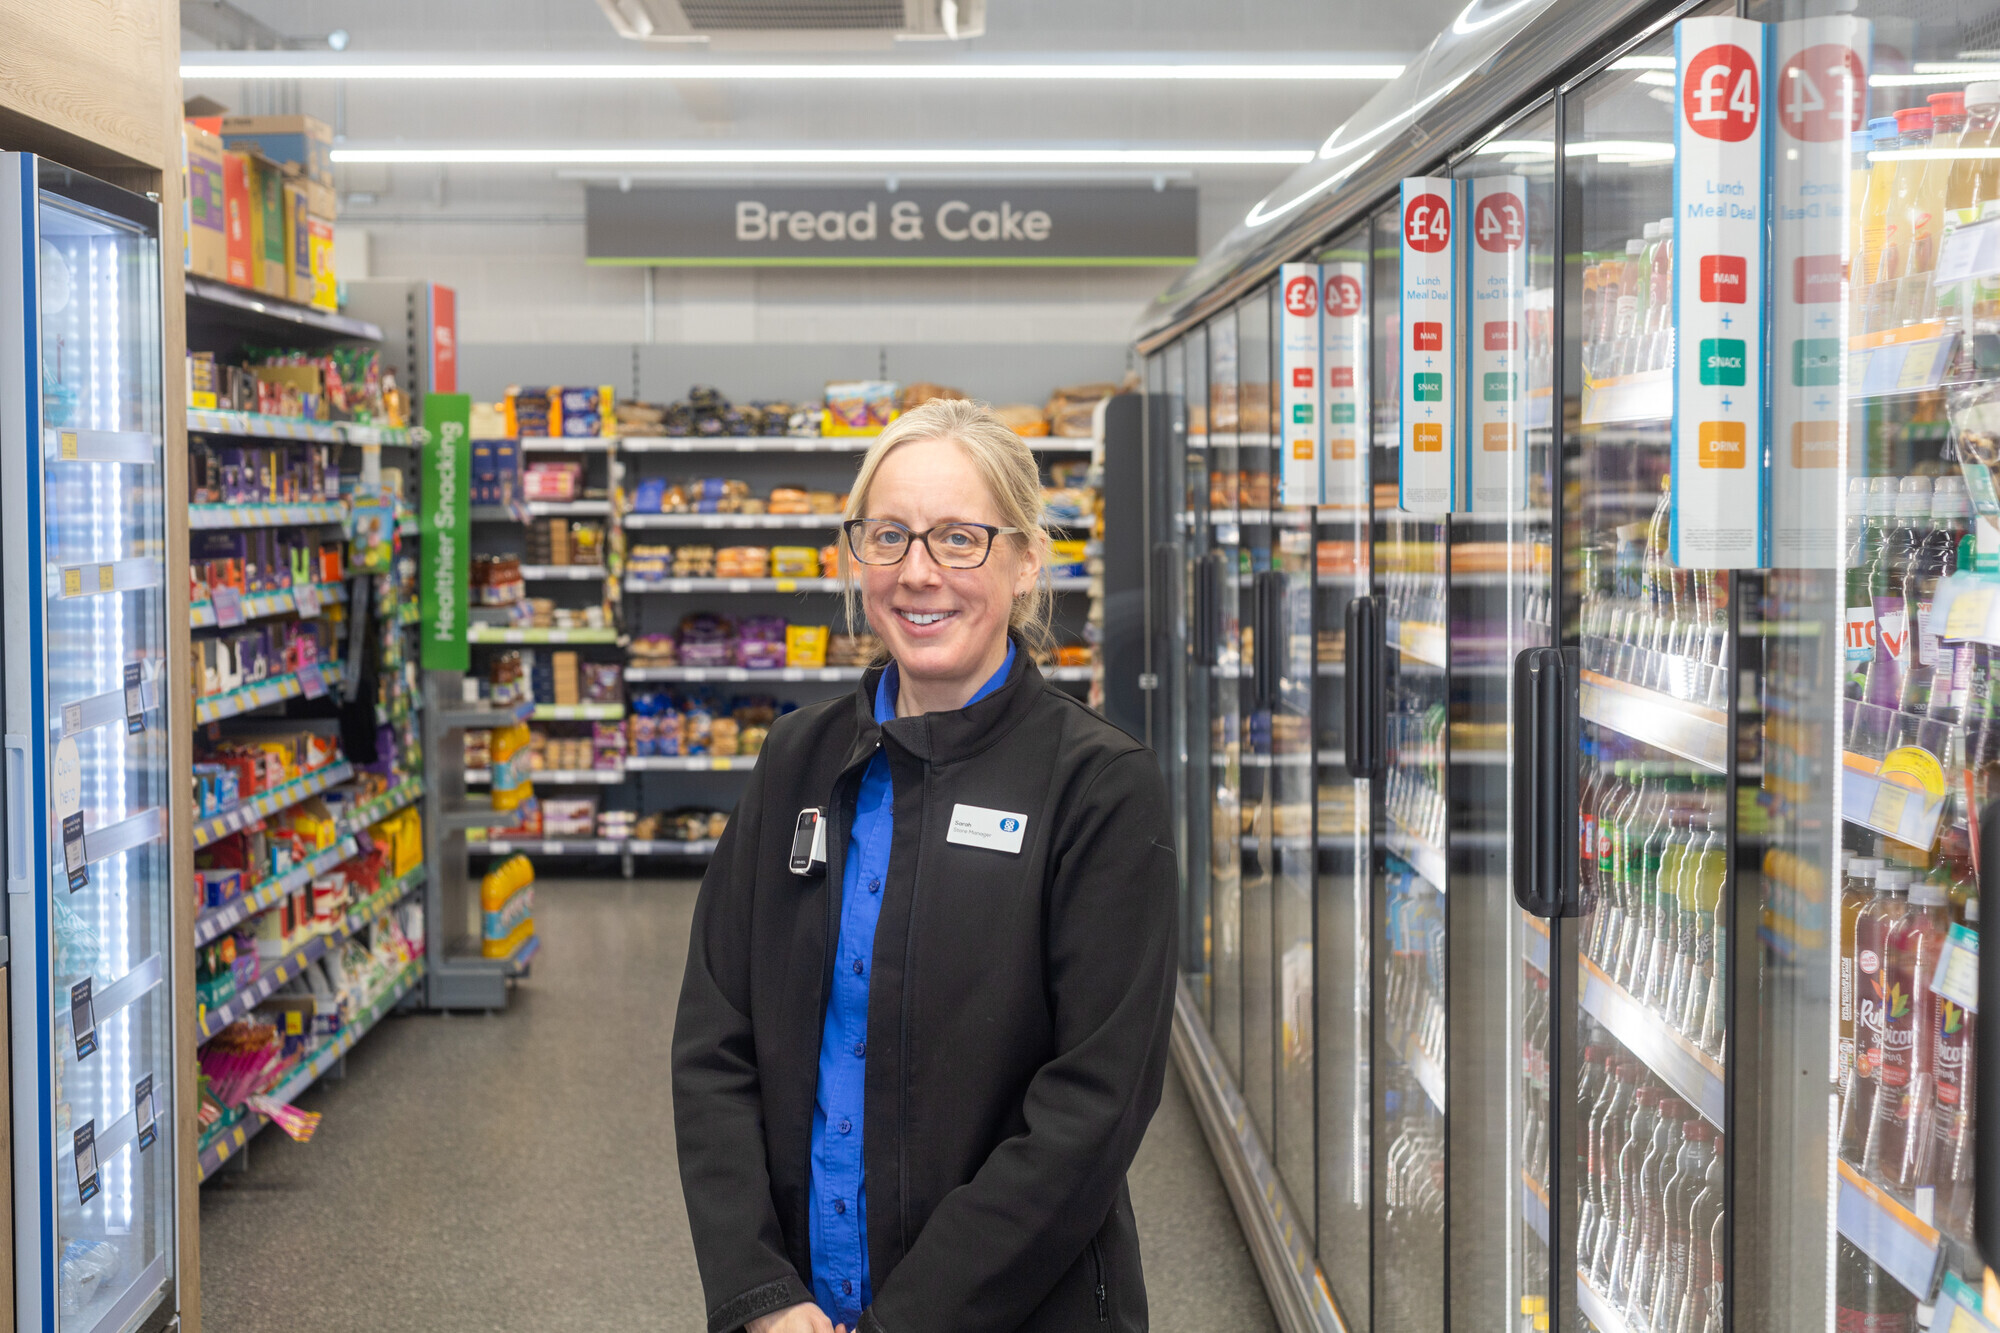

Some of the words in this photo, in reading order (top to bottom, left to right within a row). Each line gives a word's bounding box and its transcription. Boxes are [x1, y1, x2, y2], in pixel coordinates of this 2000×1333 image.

[1693, 64, 1755, 123] £4
[1706, 180, 1745, 197] Lunch
[1687, 202, 1727, 218] Meal
[1730, 203, 1756, 220] Deal
[736, 201, 877, 241] Bread
[890, 201, 924, 241] &
[936, 200, 1052, 241] Cake
[1409, 206, 1448, 242] £4
[1416, 276, 1441, 286] Lunch
[1713, 272, 1739, 285] MAIN
[1288, 283, 1317, 310] £4
[1406, 290, 1429, 300] Meal
[1431, 290, 1449, 301] Deal
[1420, 332, 1437, 340] MAIN
[1707, 356, 1742, 369] SNACK
[1417, 383, 1439, 391] SNACK
[1709, 440, 1740, 452] DRINK
[434, 421, 464, 529] Snacking
[434, 532, 456, 642] Healthier
[954, 820, 972, 828] Sarah
[968, 829, 992, 839] Manager
